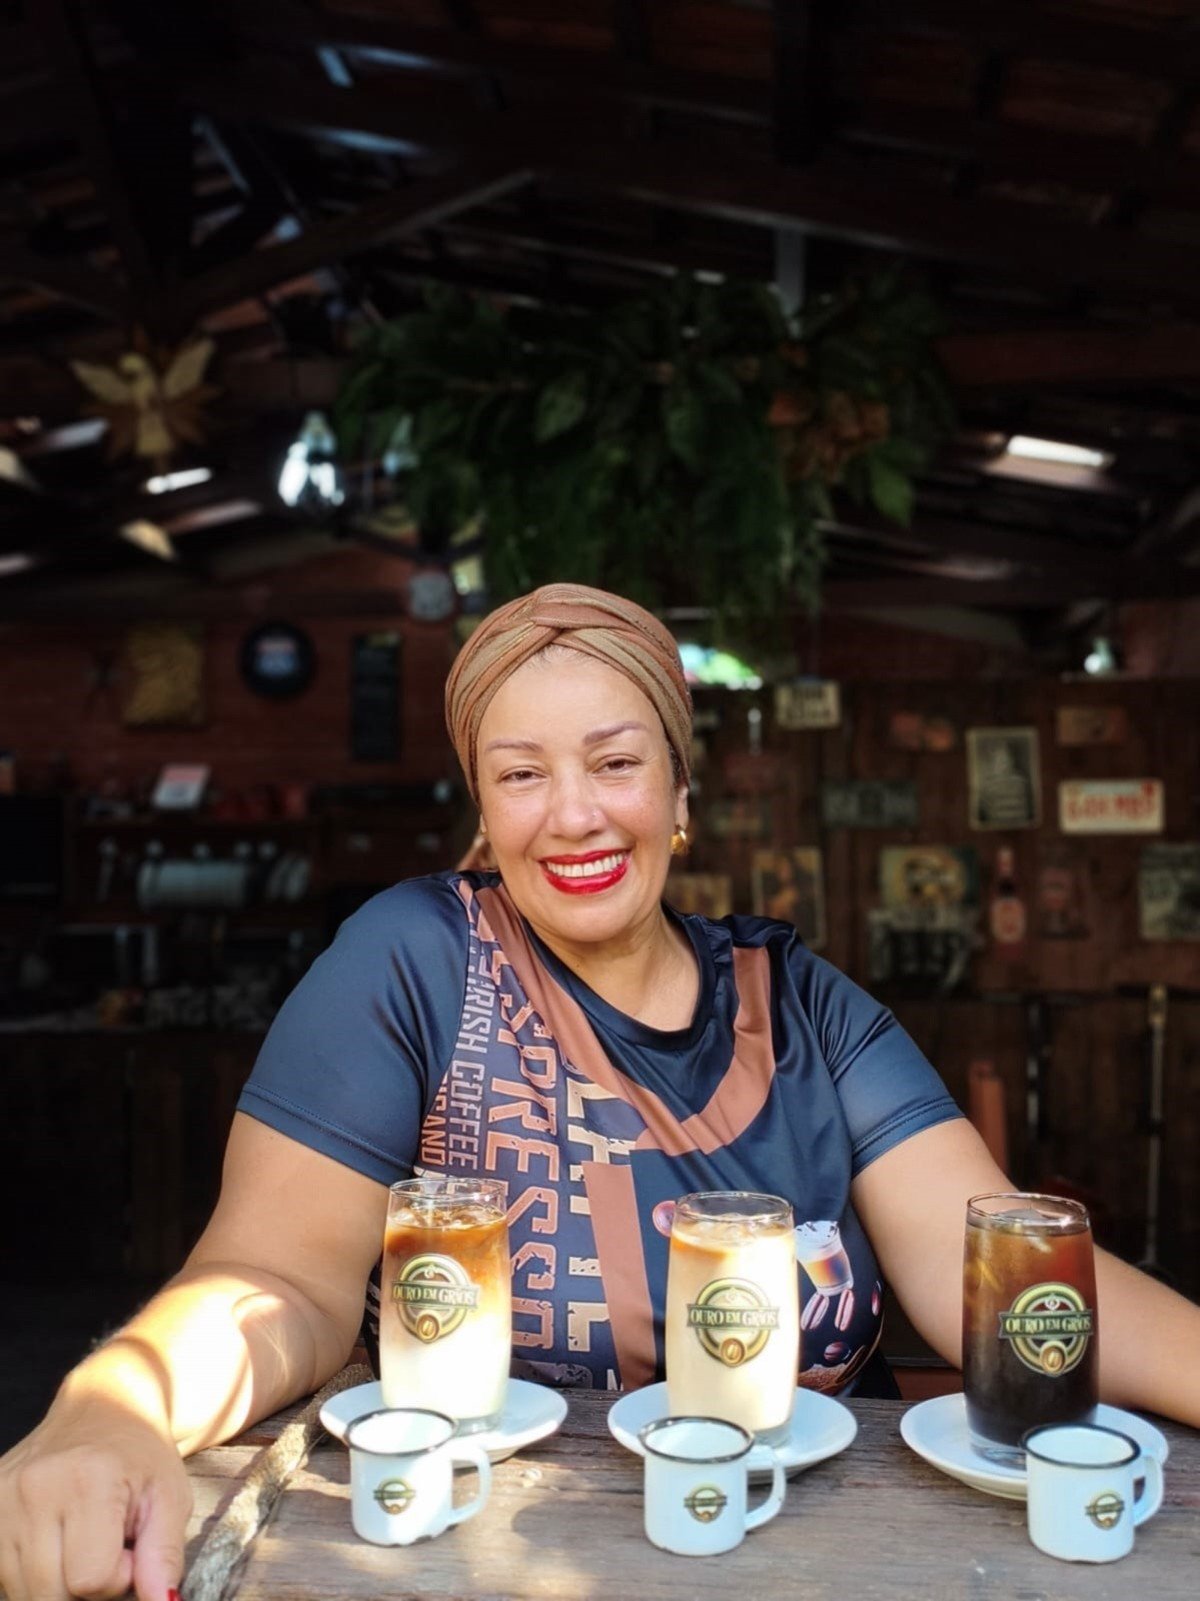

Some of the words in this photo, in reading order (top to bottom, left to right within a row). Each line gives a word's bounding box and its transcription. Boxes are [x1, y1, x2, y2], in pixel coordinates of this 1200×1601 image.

[455, 977, 496, 1054] IRISH
[448, 1059, 486, 1171] COFFEE
[566, 1076, 637, 1353] LAE
[393, 1285, 421, 1301] OURO
[423, 1287, 437, 1300] EM
[690, 1307, 724, 1325] OURO
[725, 1310, 741, 1324] EM
[1005, 1317, 1045, 1334] OURO
[1046, 1318, 1060, 1331] EM
